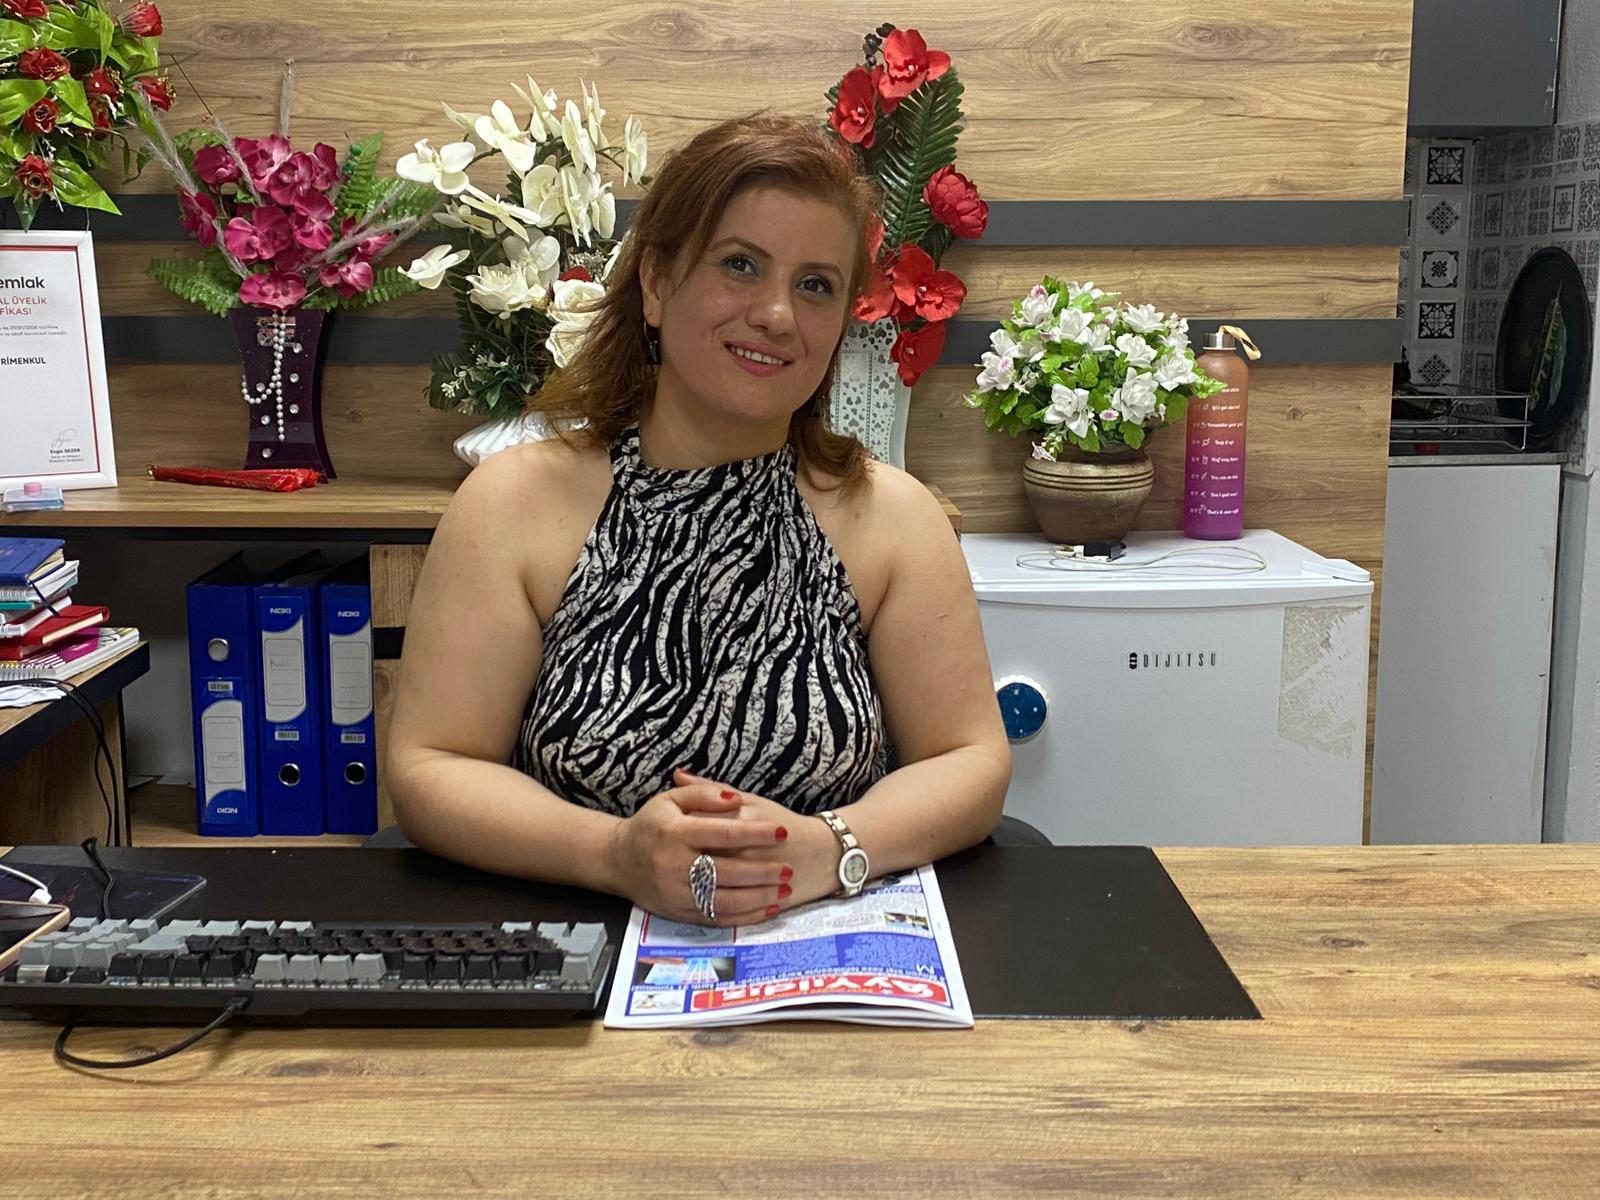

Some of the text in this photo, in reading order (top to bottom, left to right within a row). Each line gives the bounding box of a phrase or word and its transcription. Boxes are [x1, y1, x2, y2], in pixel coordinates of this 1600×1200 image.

[0, 276, 45, 289] emlak
[12, 295, 47, 305] ÜYELİK
[1, 356, 46, 365] RİMENKUL
[270, 607, 292, 615] NOKI
[1143, 652, 1216, 668] DIJITSU
